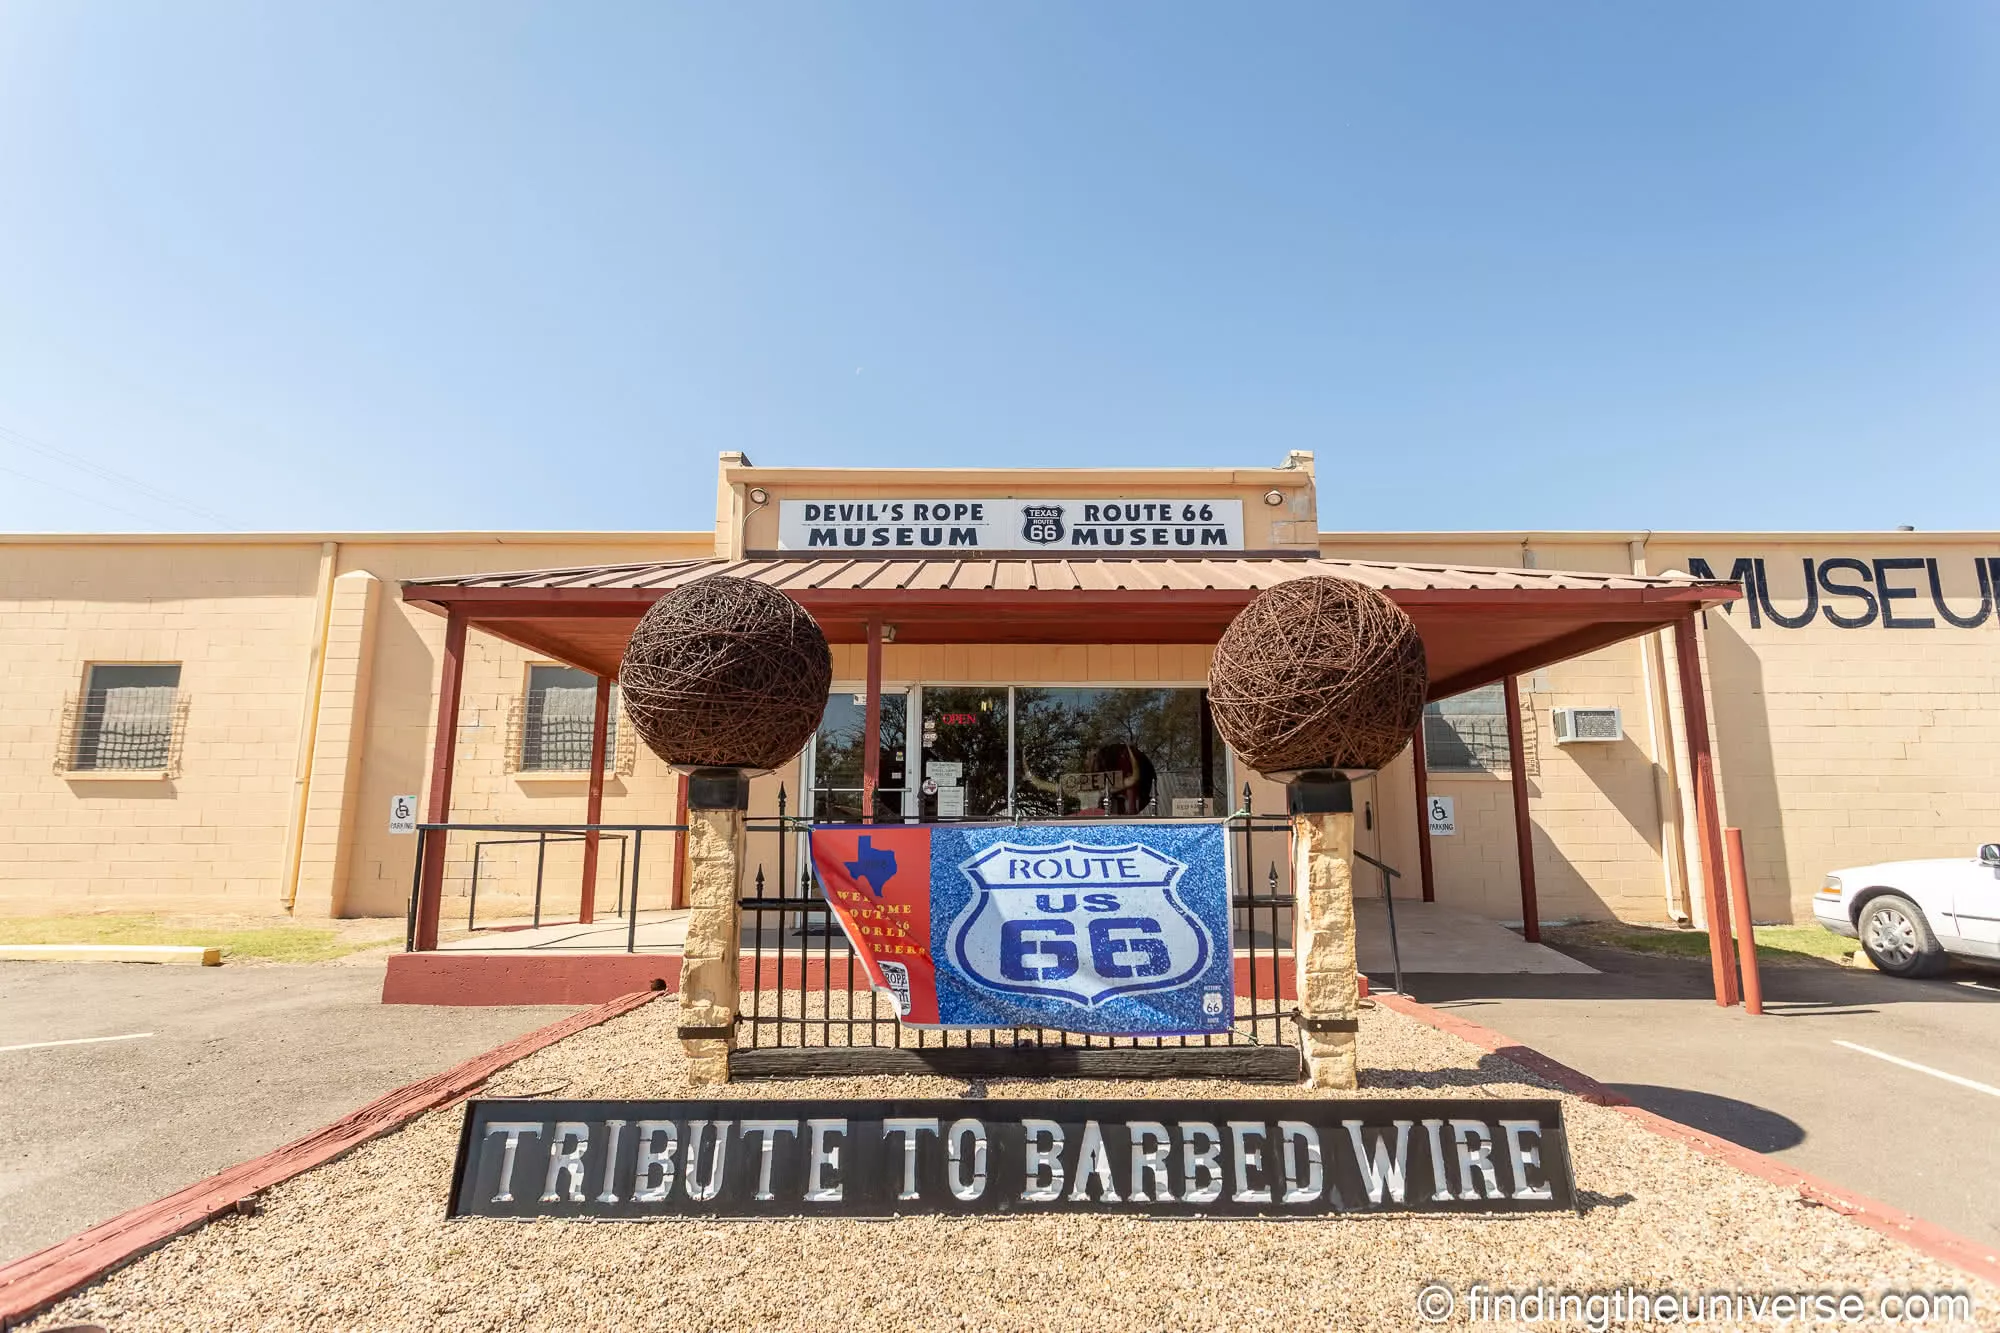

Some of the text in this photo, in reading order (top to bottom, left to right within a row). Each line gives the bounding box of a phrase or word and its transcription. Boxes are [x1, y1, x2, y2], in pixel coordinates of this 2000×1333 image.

[805, 504, 984, 521] DEVIL'S ROPE
[1084, 504, 1213, 521] ROUTE 66
[808, 528, 978, 546] MUSEUM
[1031, 525, 1057, 540] 66
[1072, 528, 1228, 546] MUSEUM
[1688, 558, 2000, 629] MUSEU
[942, 713, 976, 725] OPEN
[1065, 772, 1116, 791] OPEN
[391, 822, 414, 830] PARKING
[1009, 857, 1141, 881] ROUTE
[1036, 893, 1121, 914] US
[1001, 918, 1171, 982] 66
[1206, 1003, 1220, 1013] 66
[484, 1118, 1554, 1204] TRIBUTE TO BARBED WIRE
